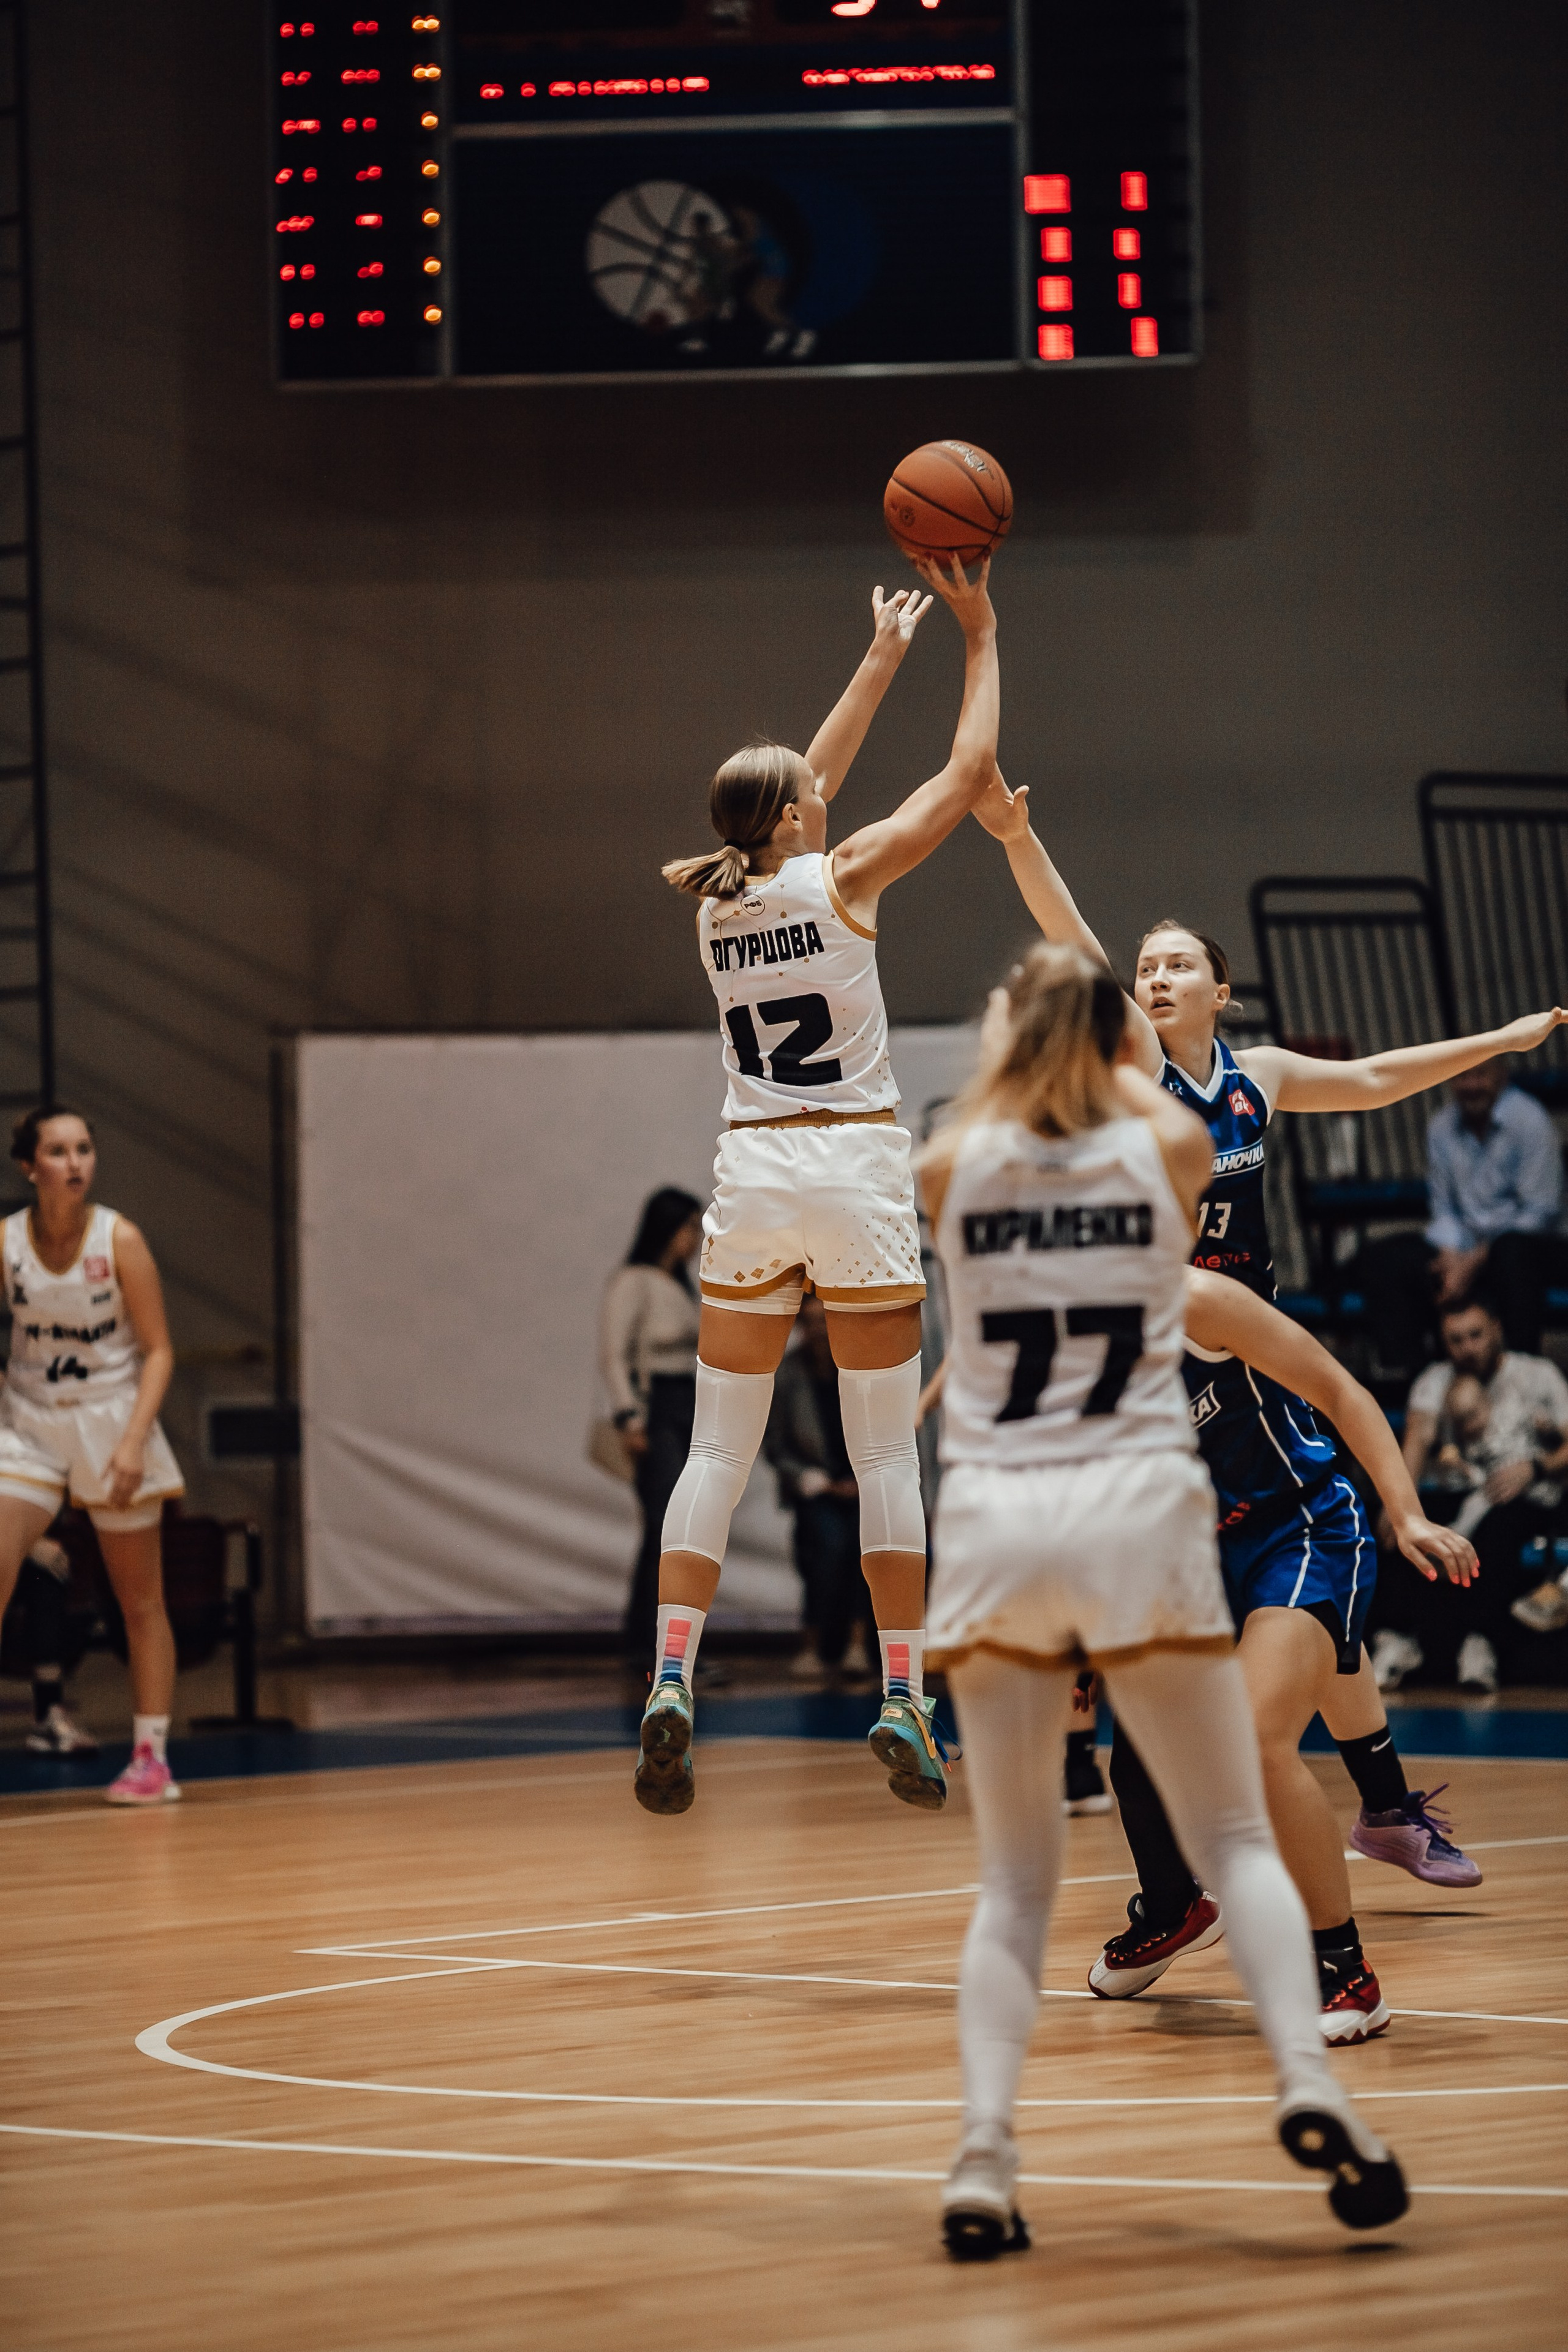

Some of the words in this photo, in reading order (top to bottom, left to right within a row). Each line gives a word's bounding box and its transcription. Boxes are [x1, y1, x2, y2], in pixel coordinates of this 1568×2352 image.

[744, 900, 762, 909] РФБ
[709, 921, 824, 971] ОГУРЦОВА
[725, 993, 843, 1086] 12
[1212, 1143, 1264, 1173] АНОЧКА
[1197, 1202, 1232, 1239] 13
[981, 1305, 1144, 1423] 77
